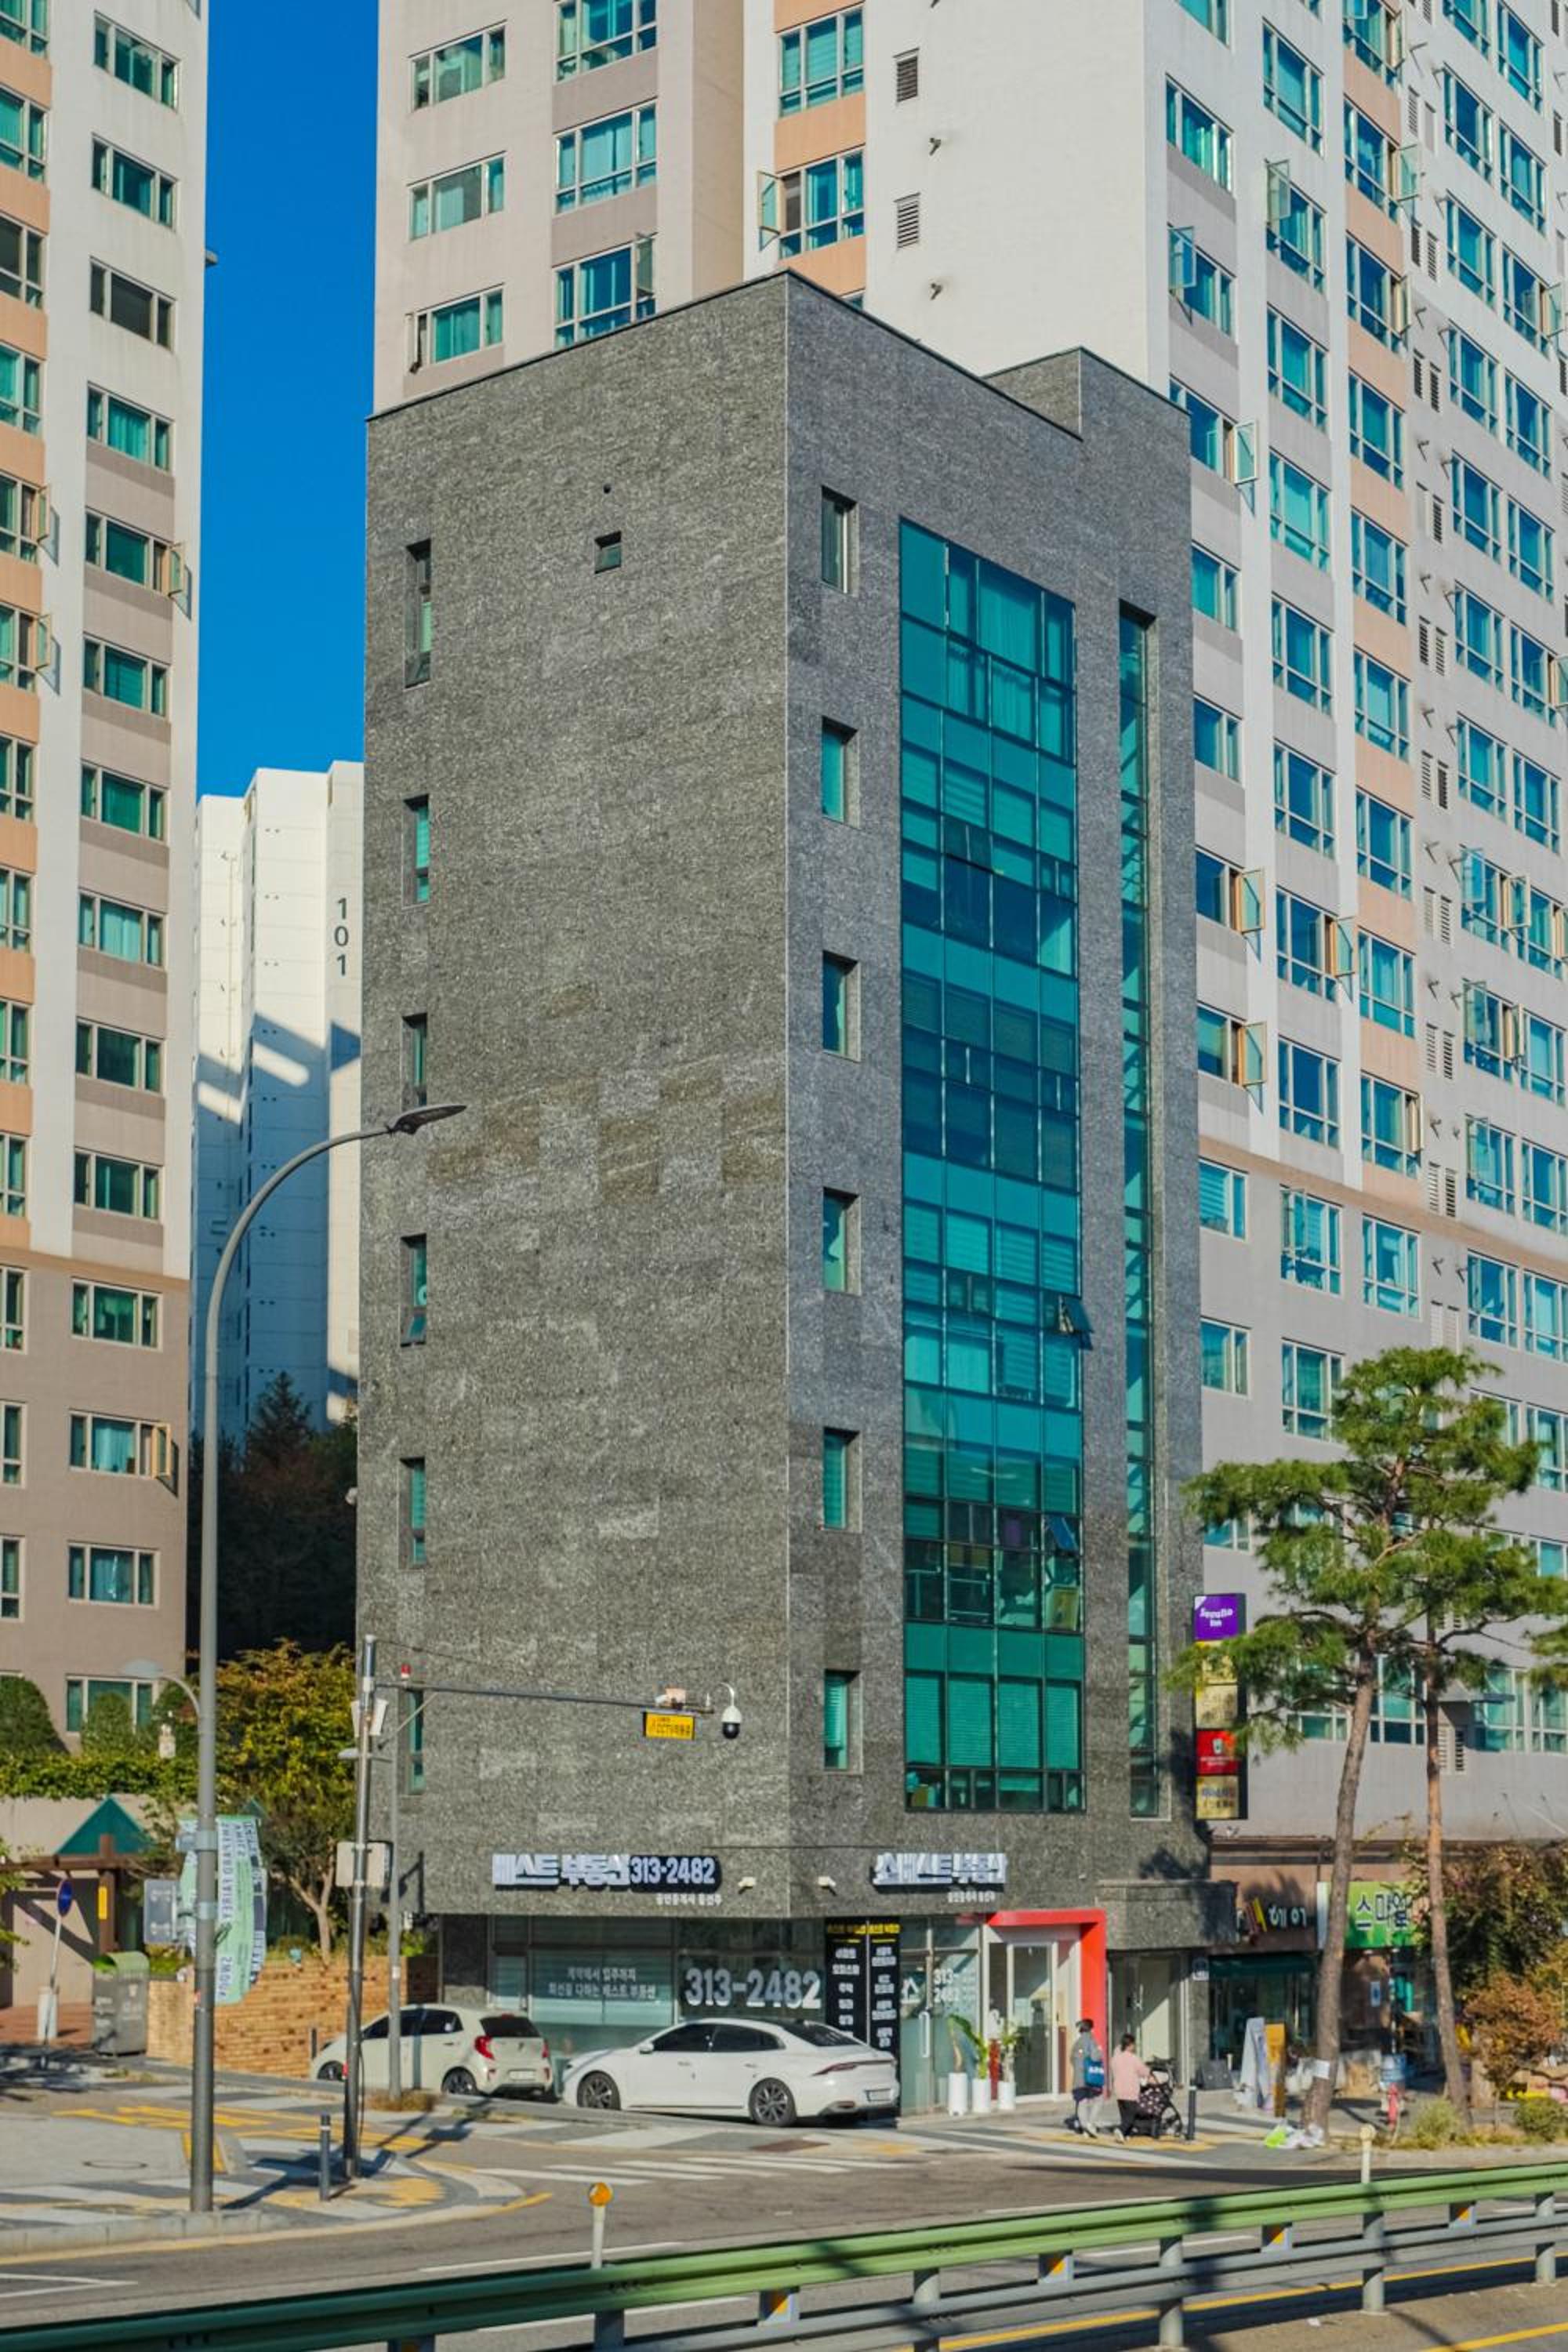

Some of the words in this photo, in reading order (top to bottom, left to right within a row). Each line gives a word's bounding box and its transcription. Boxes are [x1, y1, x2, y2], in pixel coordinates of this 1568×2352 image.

[335, 898, 349, 975] 101
[561, 1853, 630, 1886] 부동산
[630, 1857, 715, 1883] 313-2482
[685, 1967, 822, 2009] 313-2482
